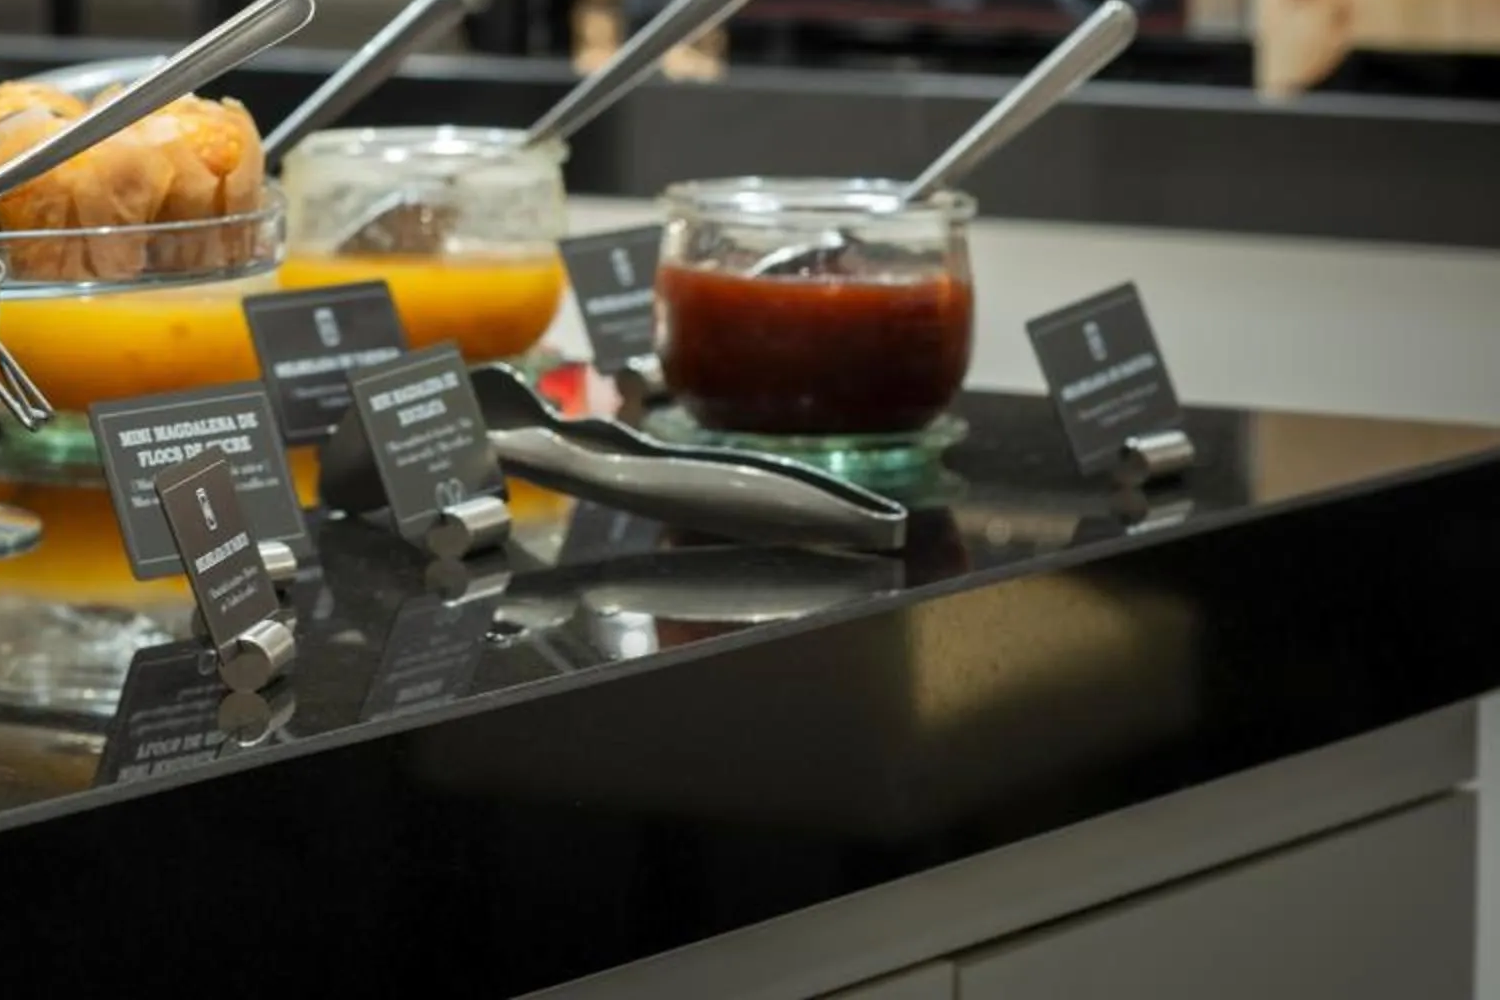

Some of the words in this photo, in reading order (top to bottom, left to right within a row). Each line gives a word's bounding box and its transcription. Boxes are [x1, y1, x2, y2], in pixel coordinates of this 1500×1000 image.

[118, 427, 153, 447] MINI
[153, 416, 238, 442] MAGDALENA
[237, 412, 259, 430] DE
[137, 447, 184, 468] FLOCS
[205, 435, 252, 454] CRE
